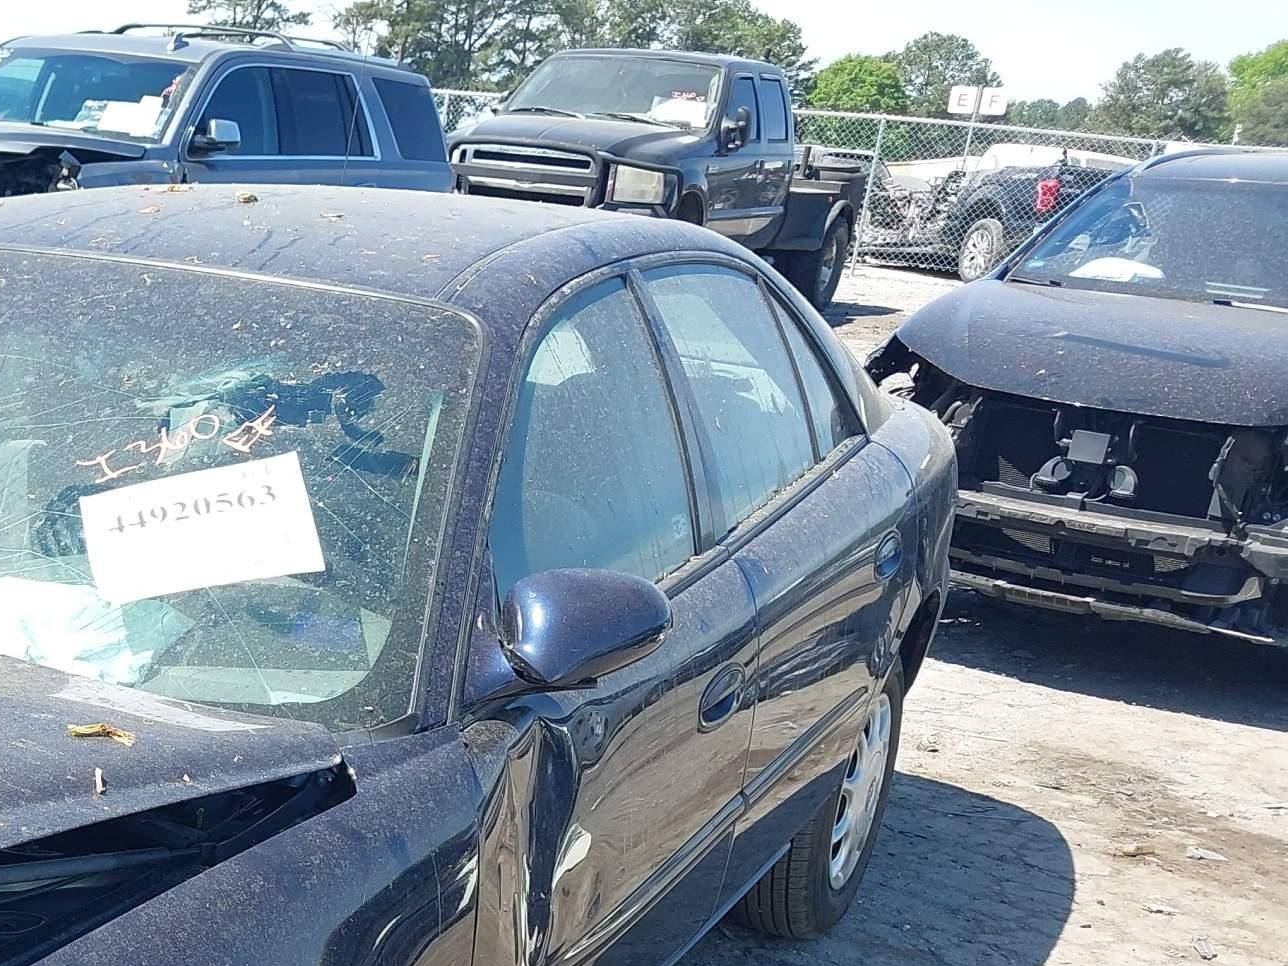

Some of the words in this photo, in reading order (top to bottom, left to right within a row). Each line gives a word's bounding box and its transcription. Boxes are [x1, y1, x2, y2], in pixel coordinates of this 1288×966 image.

[958, 94, 969, 107] E
[989, 95, 1001, 108] F
[108, 485, 276, 533] 44920563
